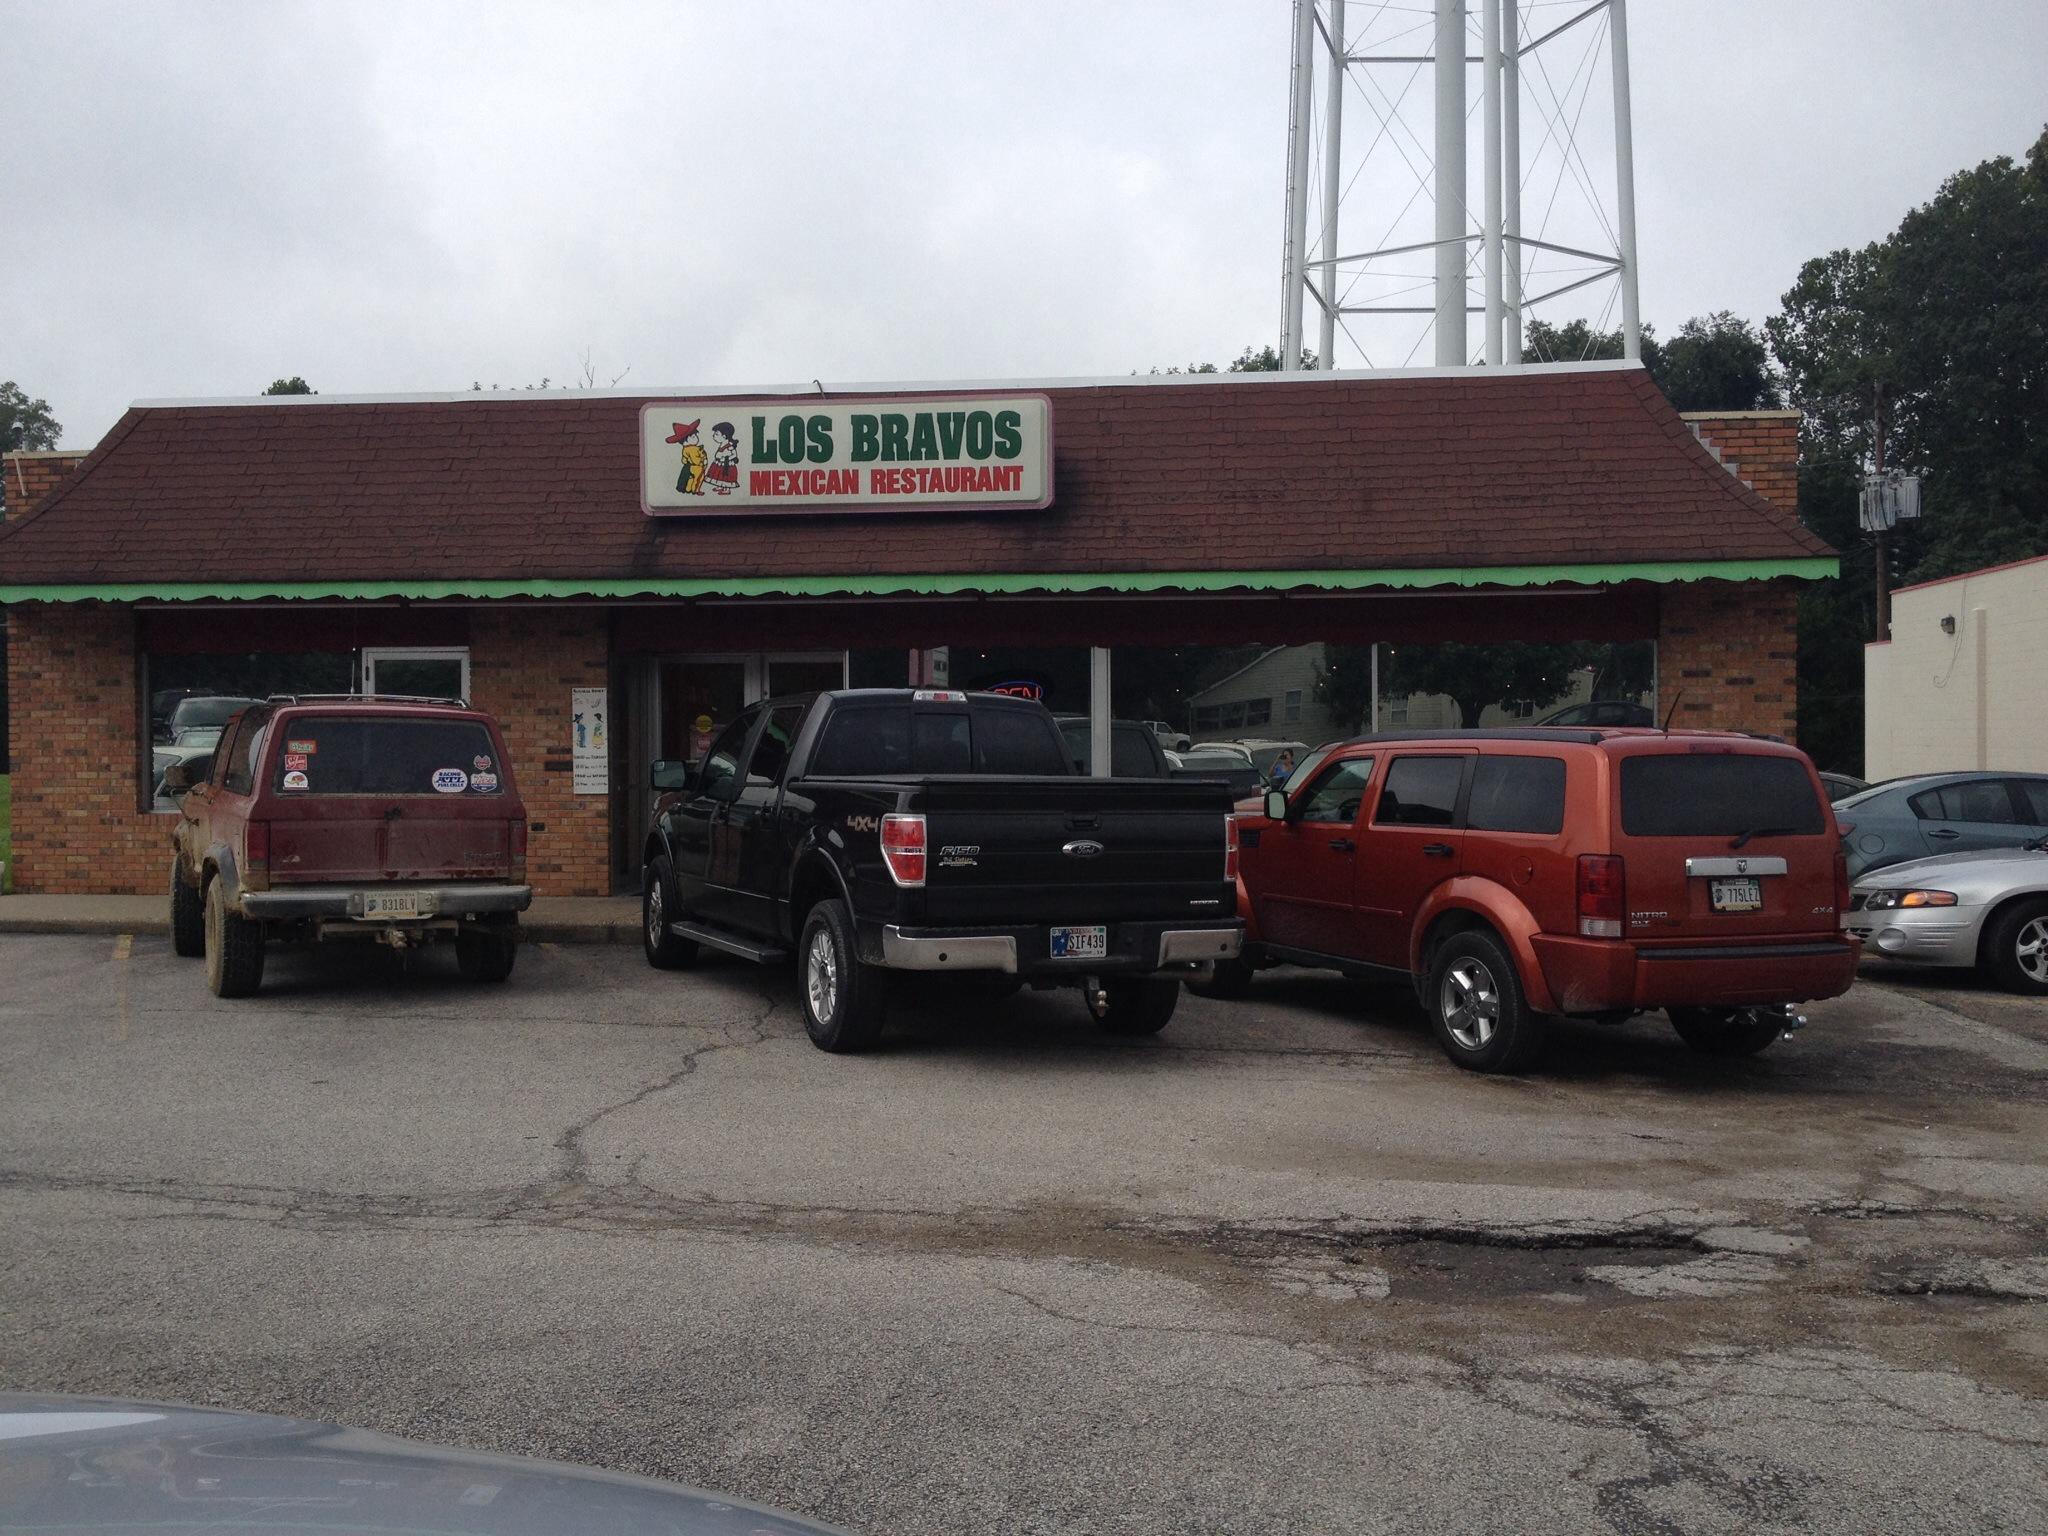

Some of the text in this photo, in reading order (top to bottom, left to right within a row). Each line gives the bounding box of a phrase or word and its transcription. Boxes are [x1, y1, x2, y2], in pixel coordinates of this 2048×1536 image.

[751, 410, 1022, 464] LOS BRAVOS
[749, 465, 1024, 496] MEXICAN RESTAURANT
[847, 815, 880, 832] 4X4
[1631, 911, 1668, 919] NITRO
[1069, 934, 1105, 950] SIF439
